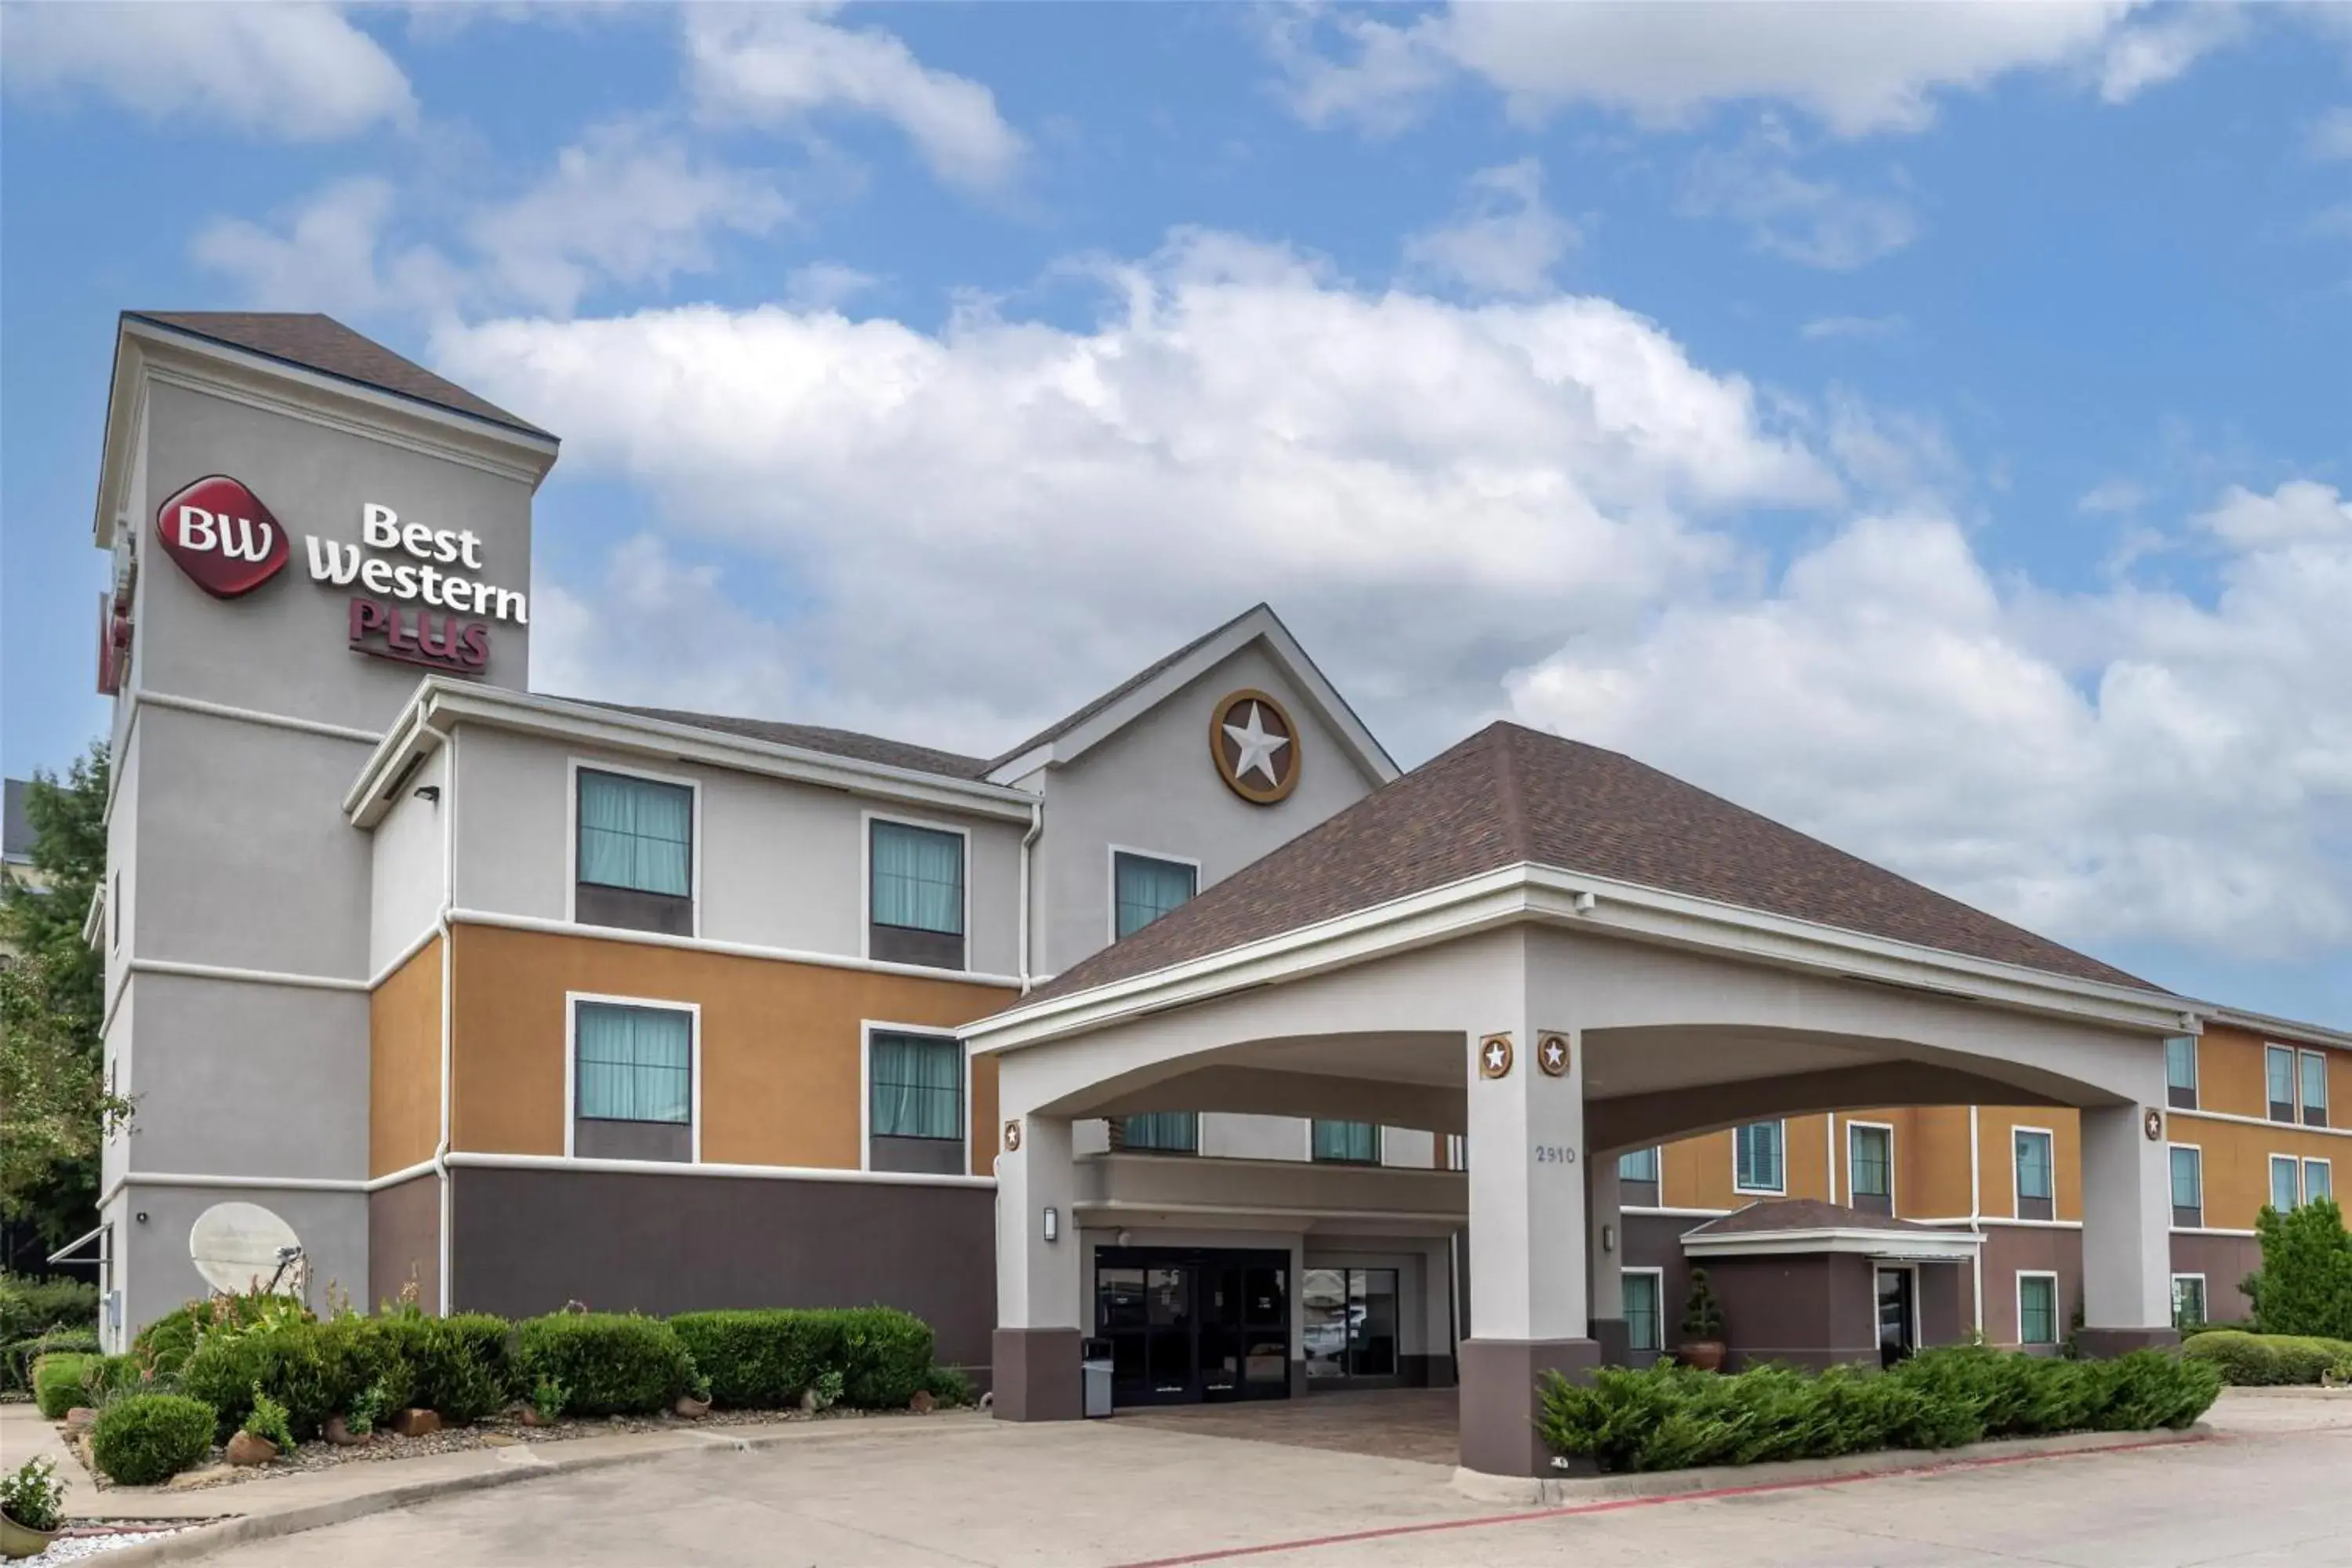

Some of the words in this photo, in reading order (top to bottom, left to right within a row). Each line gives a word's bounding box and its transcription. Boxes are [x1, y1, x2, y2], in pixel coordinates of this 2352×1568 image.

[178, 506, 273, 562] BW
[363, 503, 482, 569] Best
[305, 535, 528, 624] Western
[349, 597, 491, 666] PLUS
[1535, 1145, 1576, 1163] 2910
